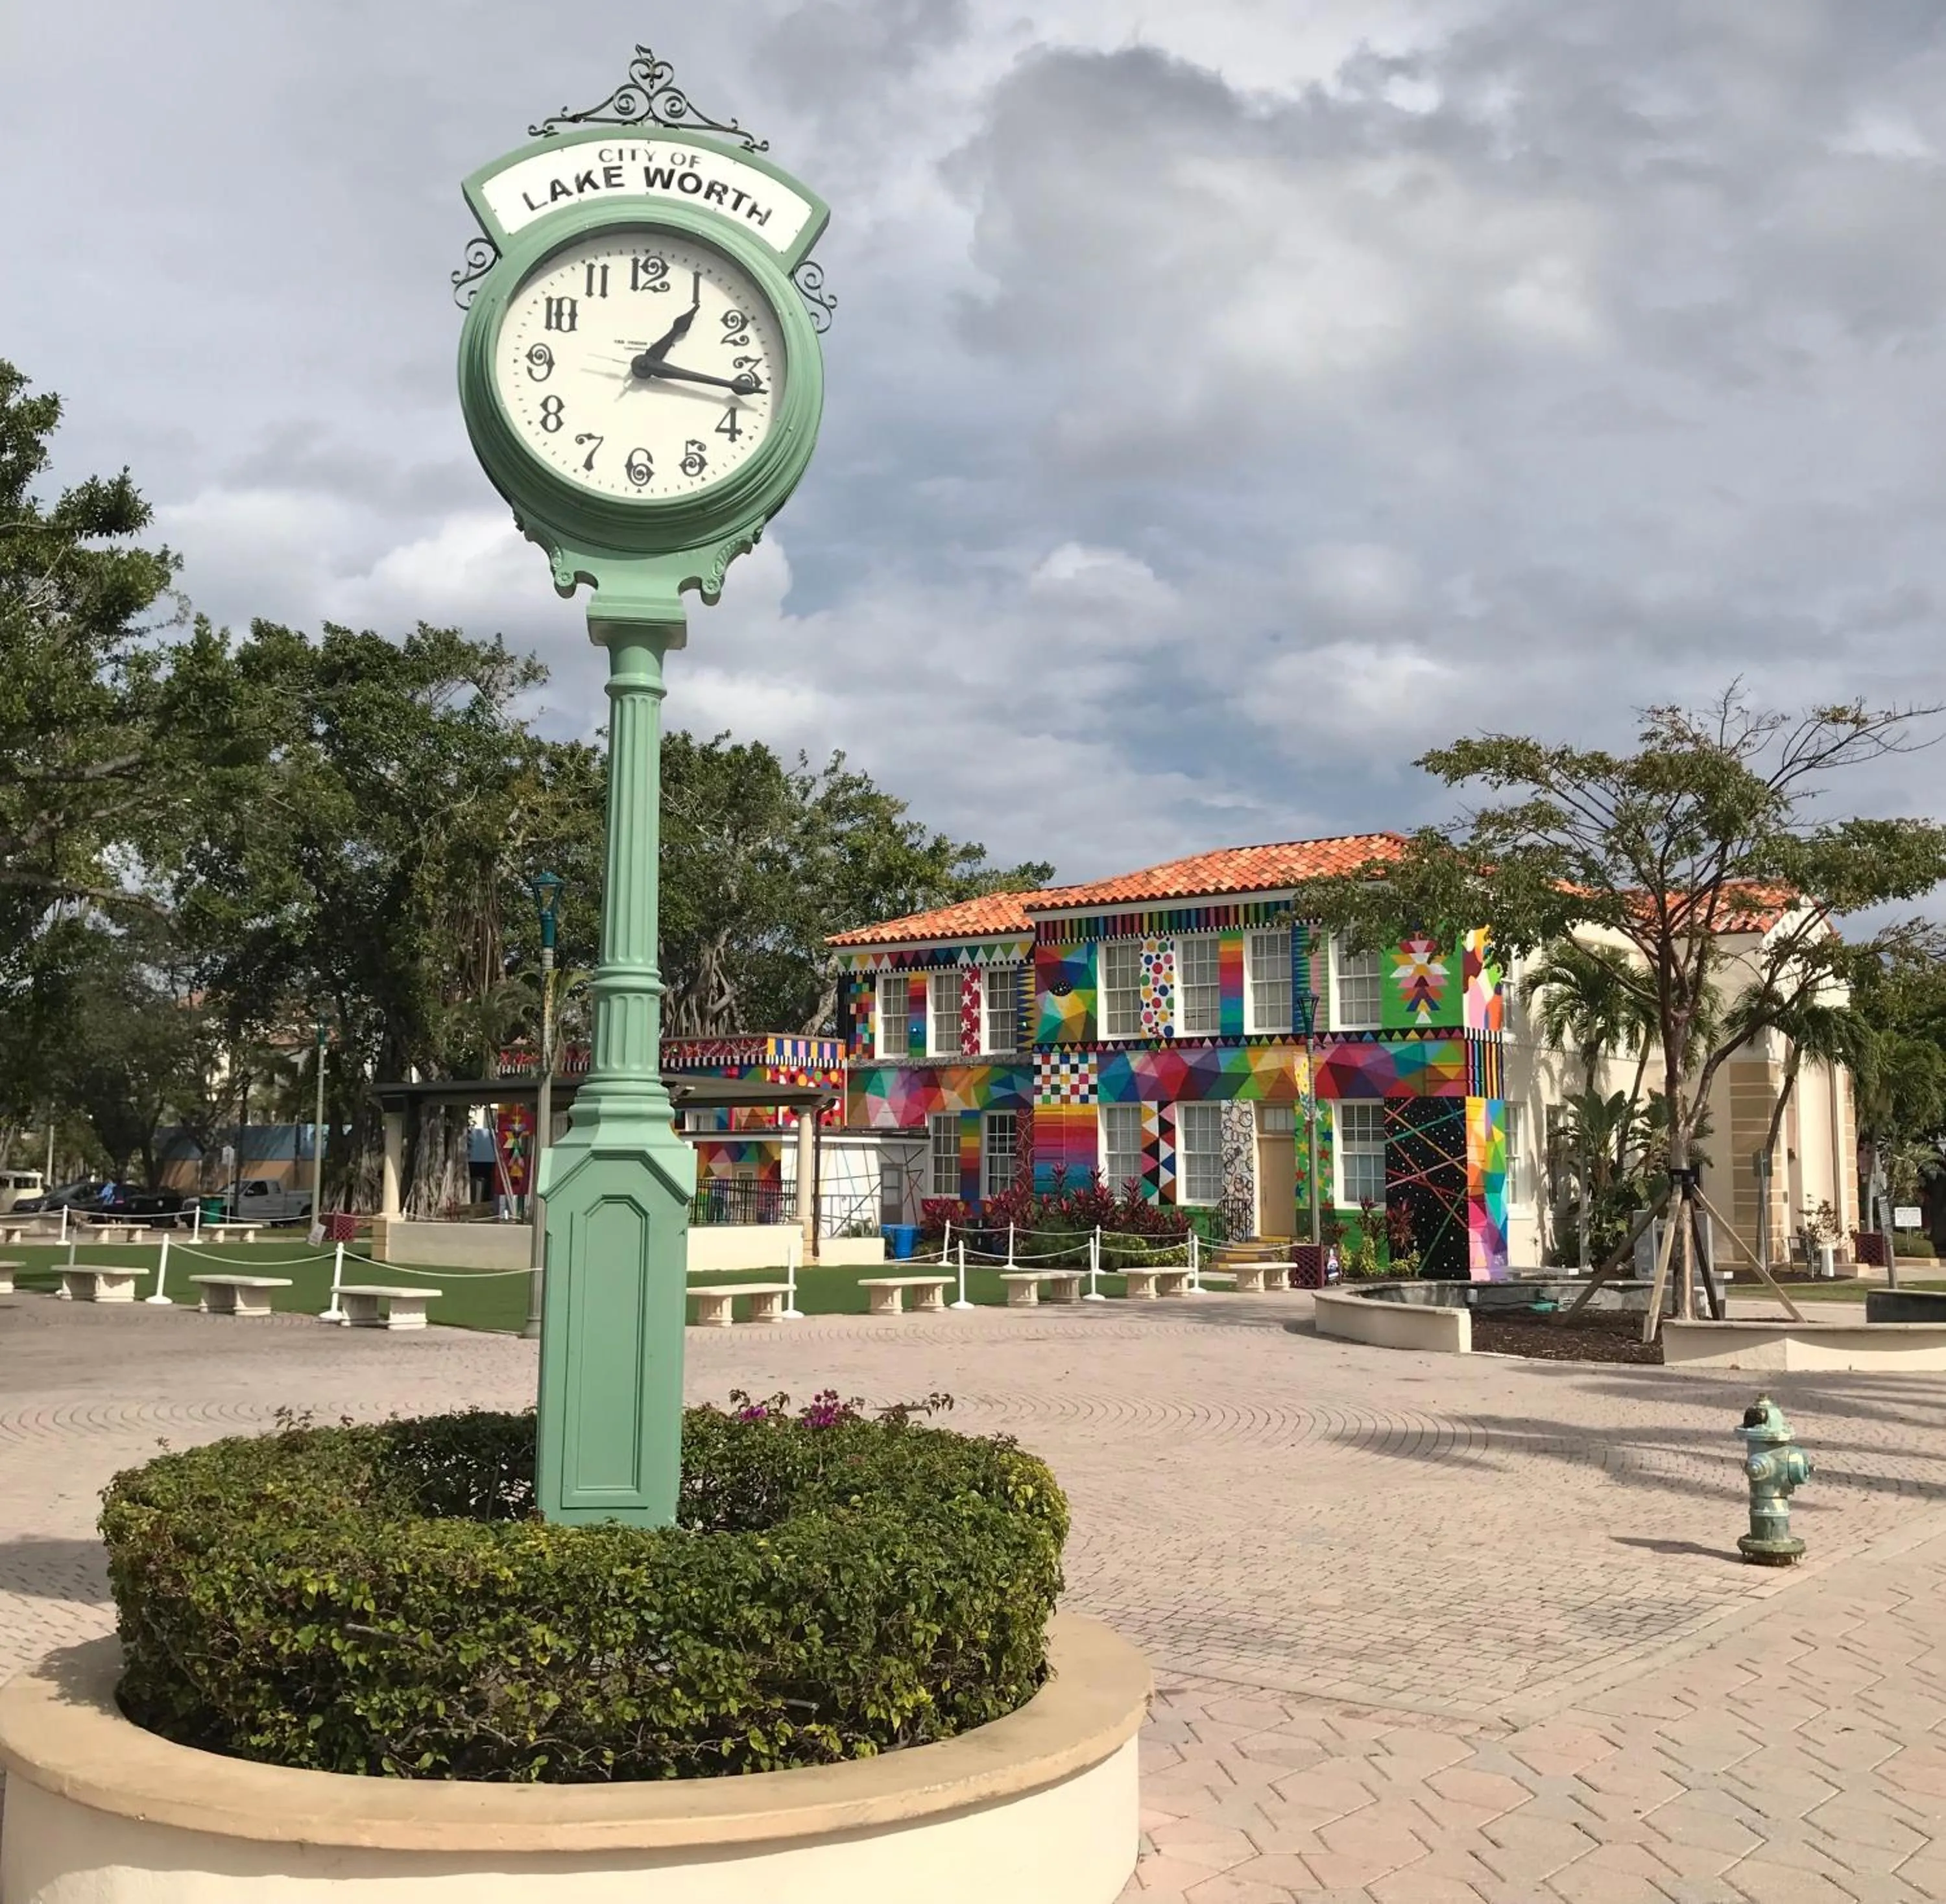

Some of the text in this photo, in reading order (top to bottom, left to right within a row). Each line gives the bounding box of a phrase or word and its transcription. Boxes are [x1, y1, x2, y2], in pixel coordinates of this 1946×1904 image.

[598, 149, 701, 169] CITY OF
[522, 165, 773, 226] LAKE WORTH
[585, 263, 609, 298] 11
[631, 255, 671, 293] 12
[691, 270, 702, 303] 1
[544, 296, 579, 333] 10
[720, 309, 751, 346] 2
[525, 343, 555, 382] 9
[732, 355, 763, 392] 3
[539, 395, 565, 433] 8
[715, 406, 743, 443] 4
[575, 433, 604, 471] 7
[625, 447, 655, 487] 6
[679, 439, 708, 477] 5
